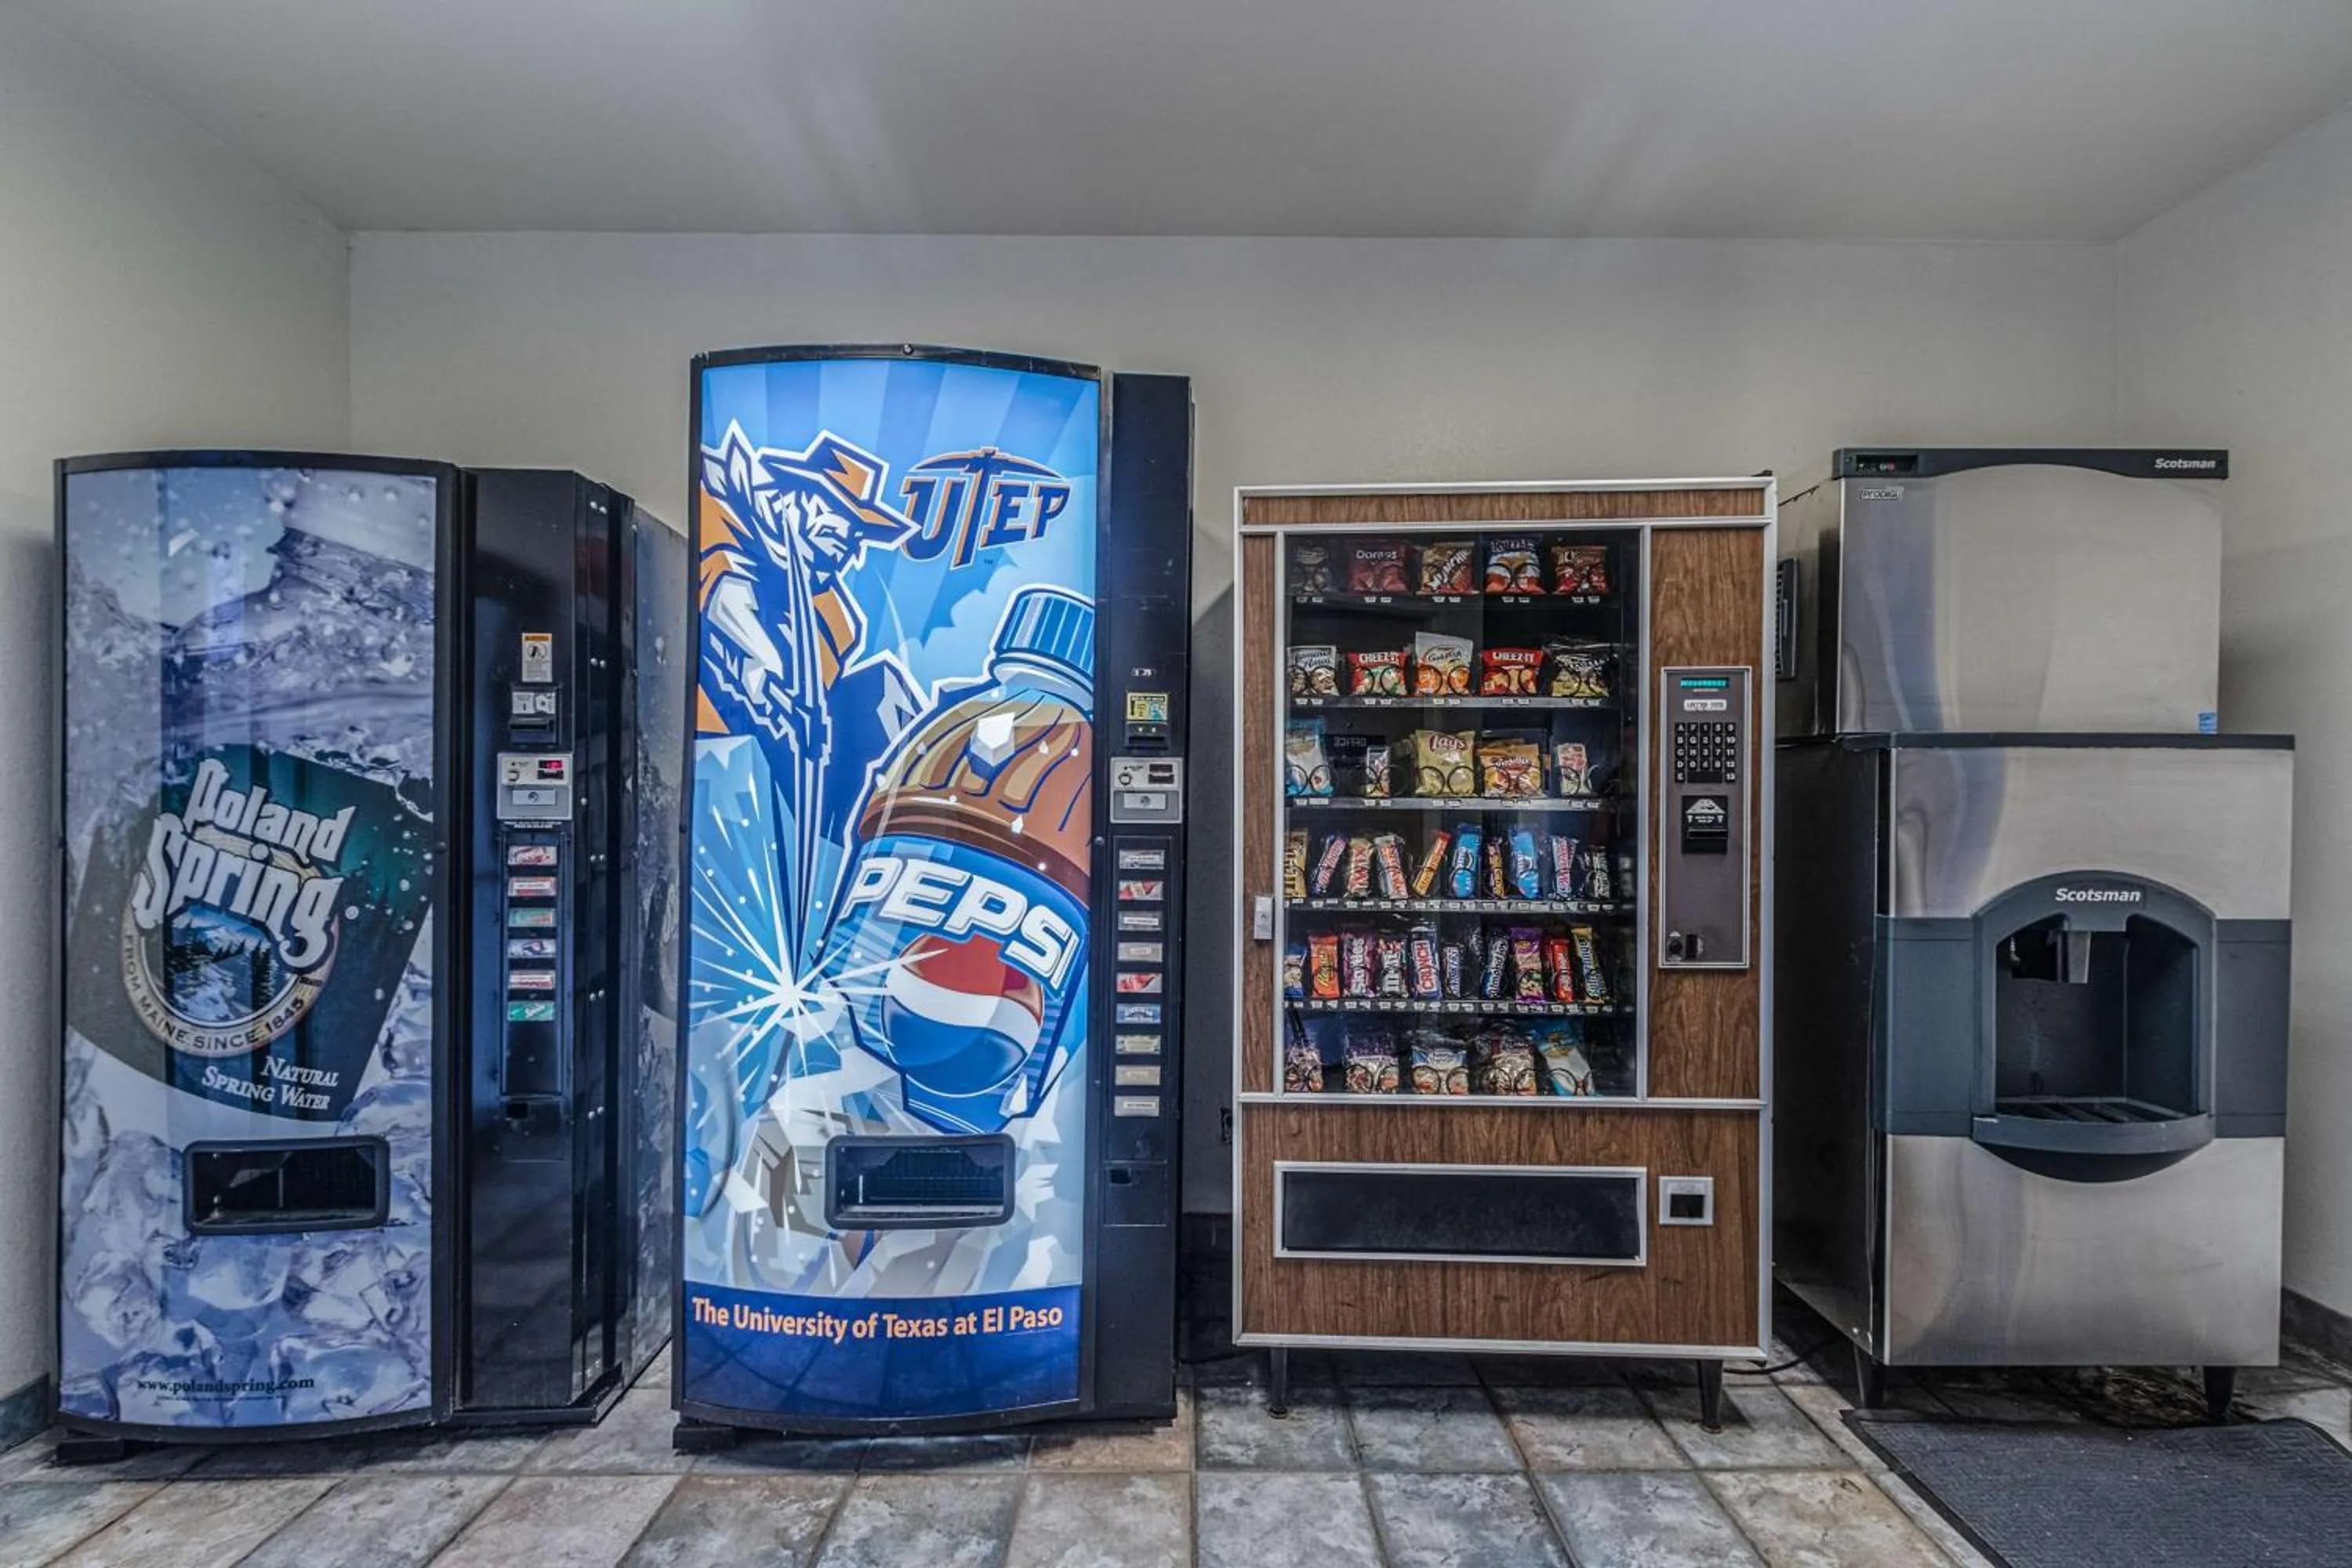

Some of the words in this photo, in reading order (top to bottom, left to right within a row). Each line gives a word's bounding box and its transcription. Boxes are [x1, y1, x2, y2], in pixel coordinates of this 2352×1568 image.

[2154, 458, 2216, 468] Scotsman
[899, 446, 1072, 571] UTEP
[183, 758, 356, 864] Poland
[132, 812, 344, 968] Spring
[2055, 888, 2141, 902] Scotsman
[840, 858, 1080, 990] PEPSI
[124, 935, 141, 991] FROM
[138, 996, 188, 1043] MAINE
[193, 1029, 260, 1051] SINCE
[265, 997, 305, 1034] 1845
[201, 1066, 275, 1102] SPRING
[281, 1085, 332, 1111] WATER
[261, 1056, 339, 1087] NATURAL
[692, 1297, 730, 1327] The
[734, 1305, 848, 1345] University
[852, 1312, 878, 1339] of
[883, 1314, 948, 1339] Texas
[953, 1312, 978, 1336] at
[982, 1306, 1004, 1333] El
[1010, 1306, 1063, 1331] Paso
[137, 1377, 314, 1395] www.polandspring.com
